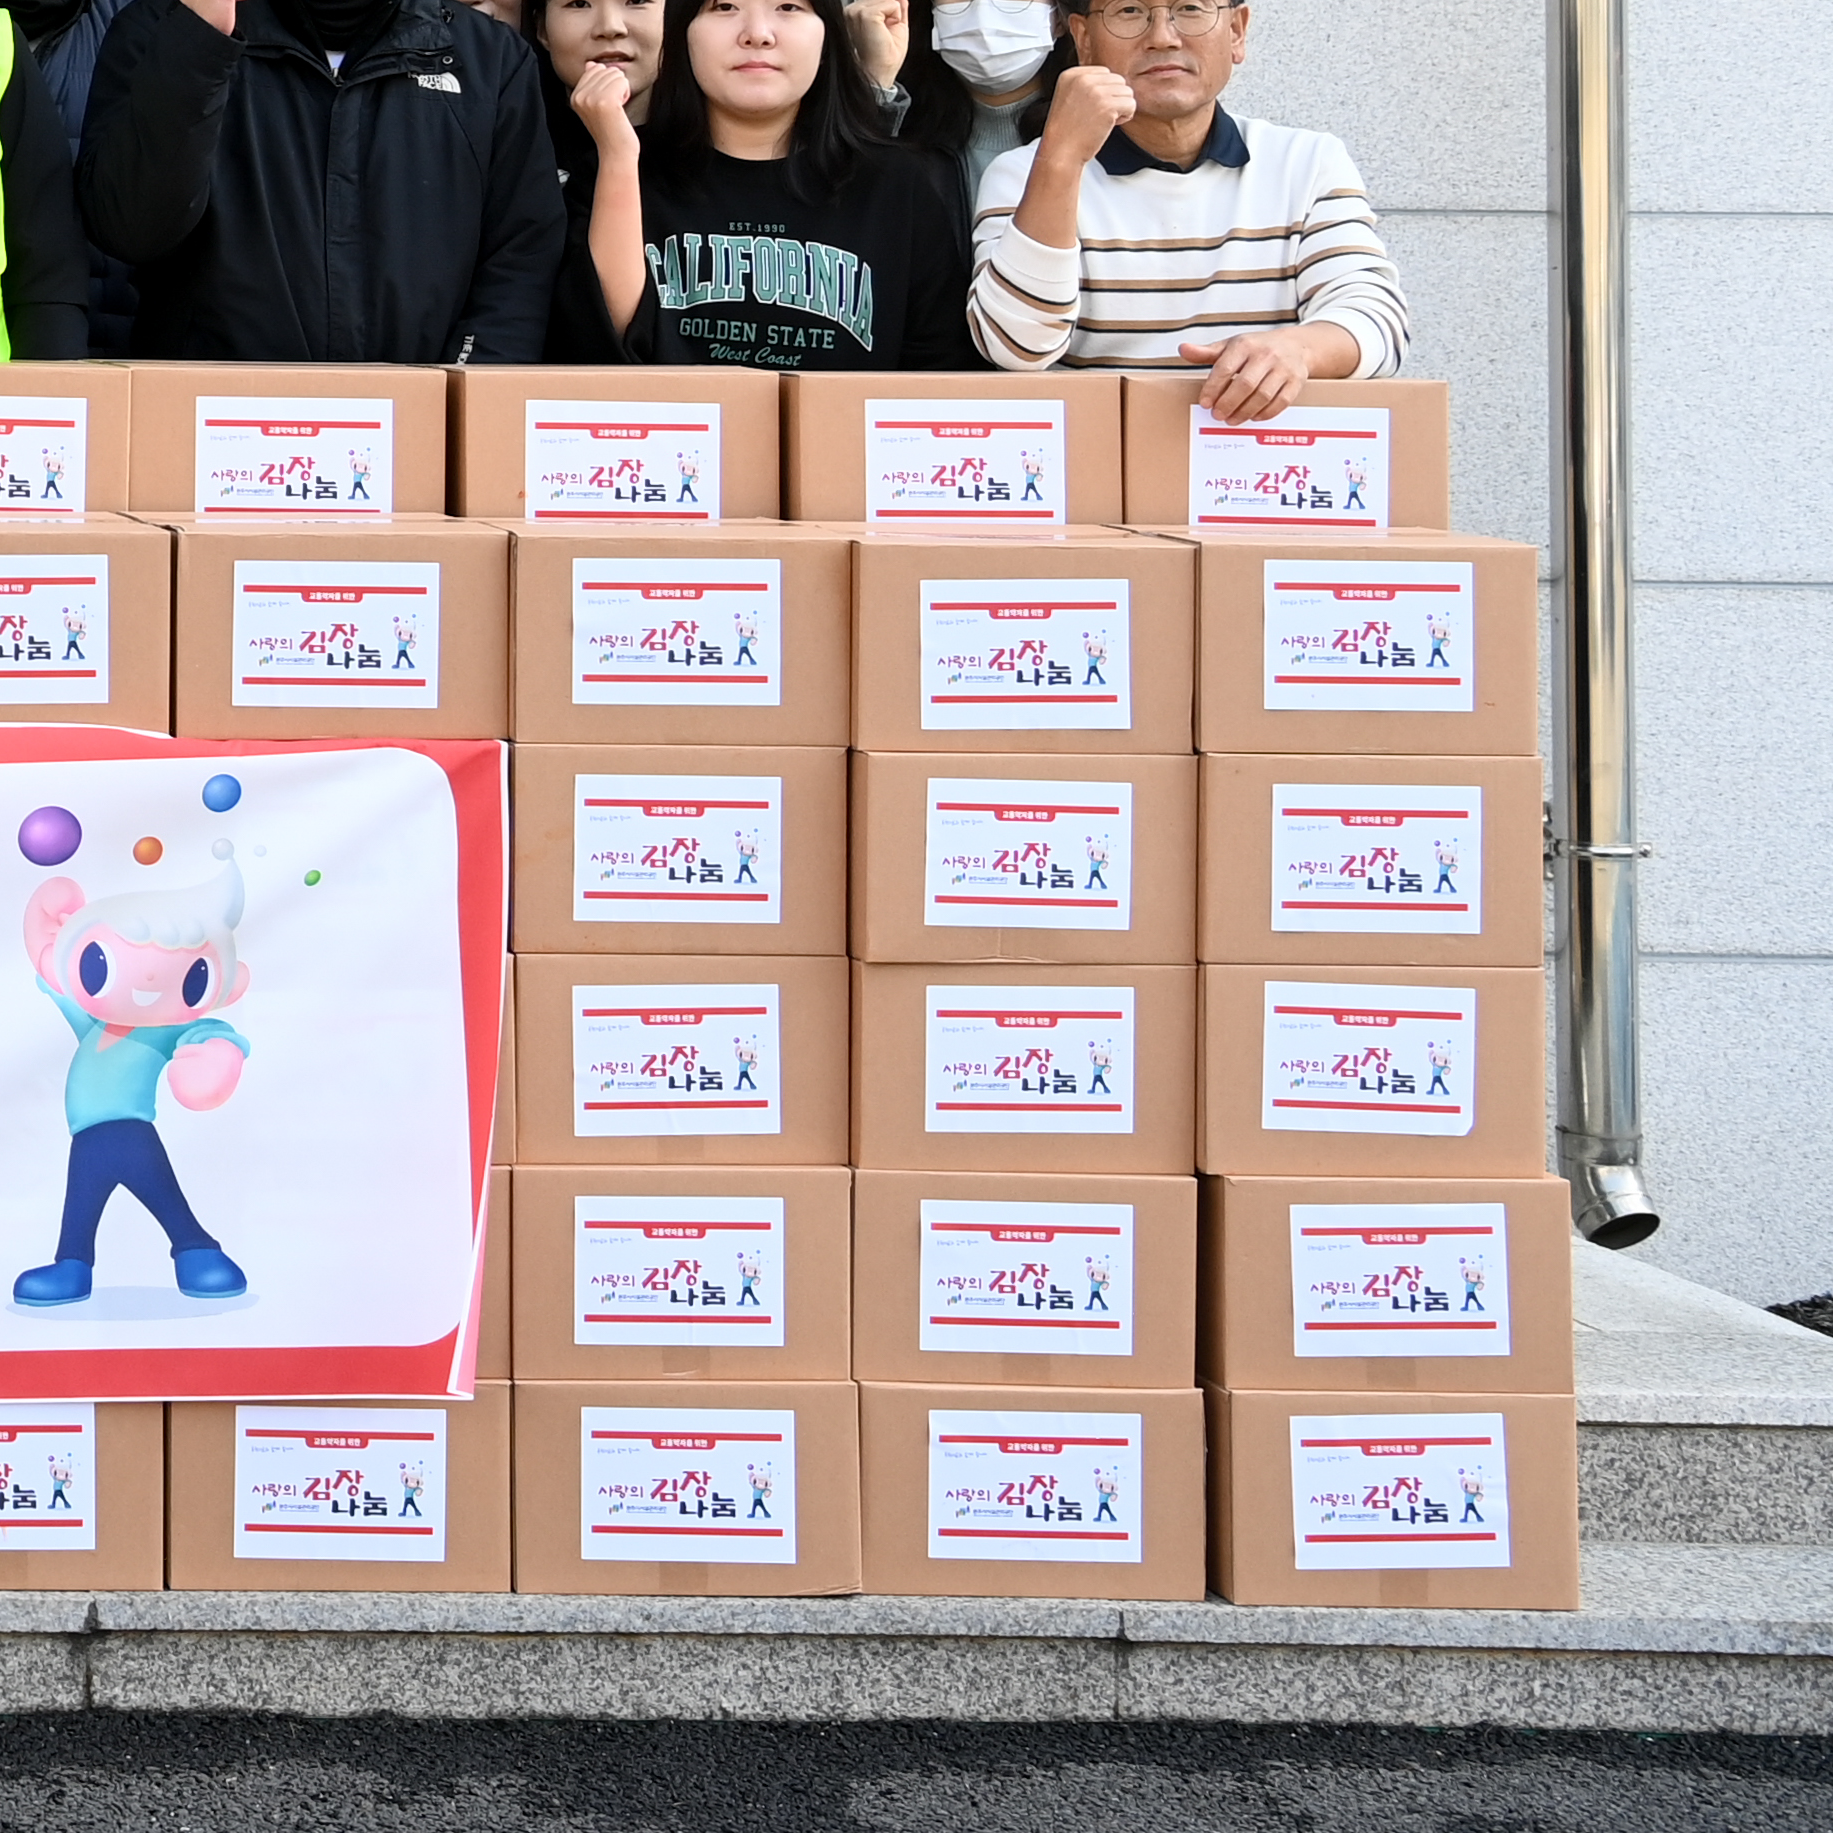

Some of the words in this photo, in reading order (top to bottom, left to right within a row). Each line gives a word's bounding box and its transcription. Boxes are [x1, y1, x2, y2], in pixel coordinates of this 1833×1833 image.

[728, 222, 786, 233] EST.1990
[645, 233, 873, 352] CALIFORNIA
[679, 318, 757, 342] GOLDEN
[767, 326, 836, 349] STATE
[708, 343, 749, 361] West
[754, 346, 802, 366] Coast
[212, 469, 253, 482] 사랑의
[259, 455, 315, 485] 김장
[882, 471, 924, 484] 사랑의
[930, 457, 988, 487] 김장
[285, 475, 338, 500] 나눔
[957, 477, 1010, 502] 나눔
[590, 634, 633, 648] 사랑의
[640, 620, 699, 651] 김장
[667, 640, 723, 666] 나눔
[938, 655, 982, 669] 사랑의
[988, 640, 1048, 671] 김장
[1016, 660, 1072, 686] 나눔
[943, 855, 986, 869] 사랑의
[992, 842, 1051, 874] 김장
[1019, 863, 1074, 889] 나눔
[590, 1061, 634, 1075] 사랑의
[640, 1045, 699, 1077] 김장
[1281, 1059, 1325, 1073] 사랑의
[1331, 1046, 1392, 1079] 김장
[667, 1066, 723, 1092] 나눔
[1359, 1068, 1416, 1095] 나눔
[937, 1276, 982, 1290] 사랑의
[989, 1262, 1050, 1295] 김장
[1017, 1284, 1074, 1311] 나눔
[252, 1483, 297, 1497] 사랑의
[303, 1469, 364, 1501] 김장
[946, 1488, 991, 1502] 사랑의
[997, 1474, 1058, 1506] 김장
[331, 1490, 388, 1517] 나눔
[1025, 1495, 1082, 1522] 나눔
